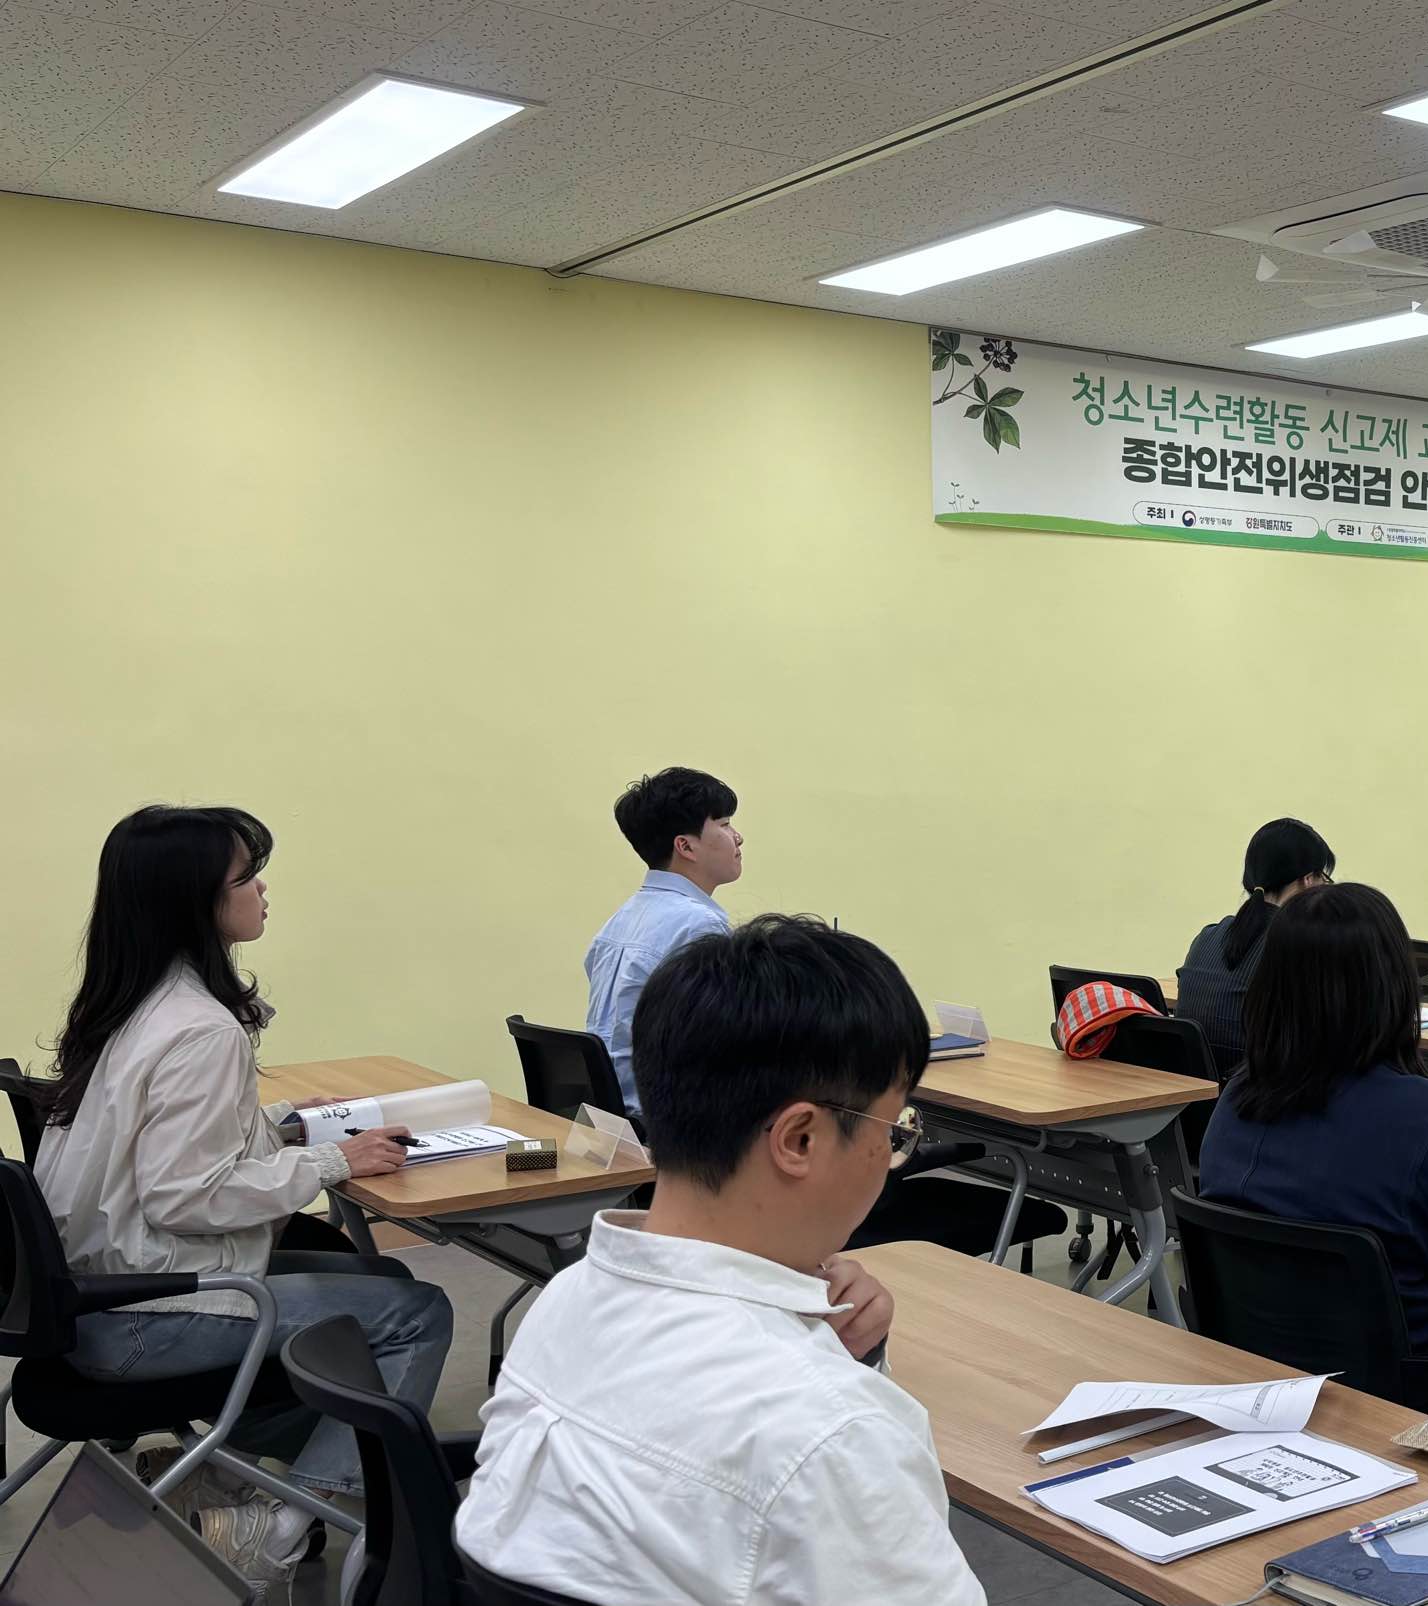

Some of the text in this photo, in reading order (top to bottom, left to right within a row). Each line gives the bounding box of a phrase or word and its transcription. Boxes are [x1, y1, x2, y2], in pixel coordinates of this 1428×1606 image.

[1071, 371, 1311, 451] 청소년수련활동
[1319, 408, 1408, 460] 신고제
[1121, 437, 1392, 508] 종합안전위생점검
[1146, 506, 1166, 520] 주최
[1337, 523, 1355, 536] 주관
